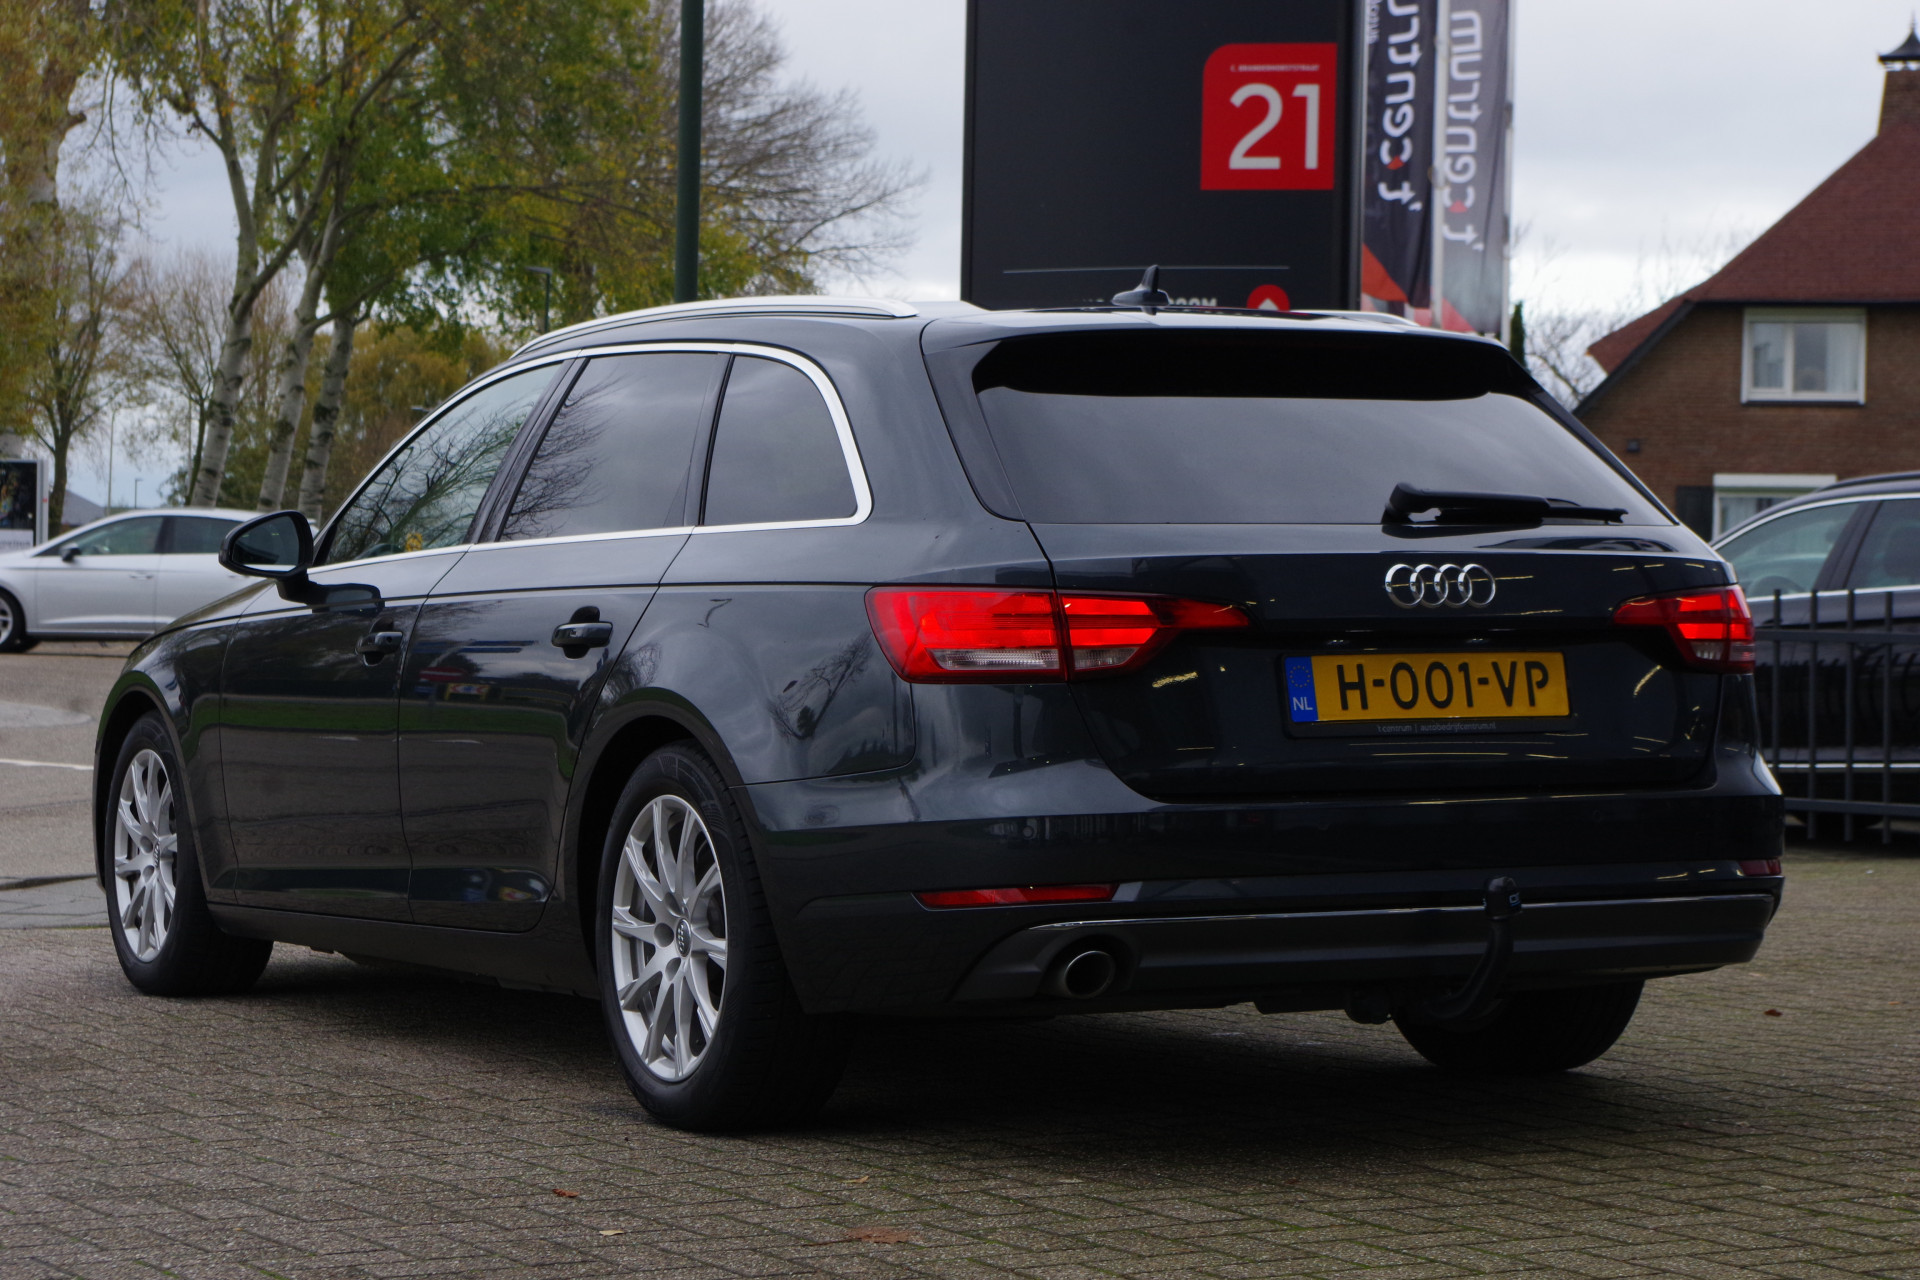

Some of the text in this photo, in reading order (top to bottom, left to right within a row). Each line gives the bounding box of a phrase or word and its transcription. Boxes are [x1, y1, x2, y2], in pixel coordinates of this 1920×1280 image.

[1229, 82, 1320, 170] 21
[1336, 660, 1549, 711] H-001-VP
[1292, 696, 1314, 712] NL
[1382, 723, 1412, 732] centrum
